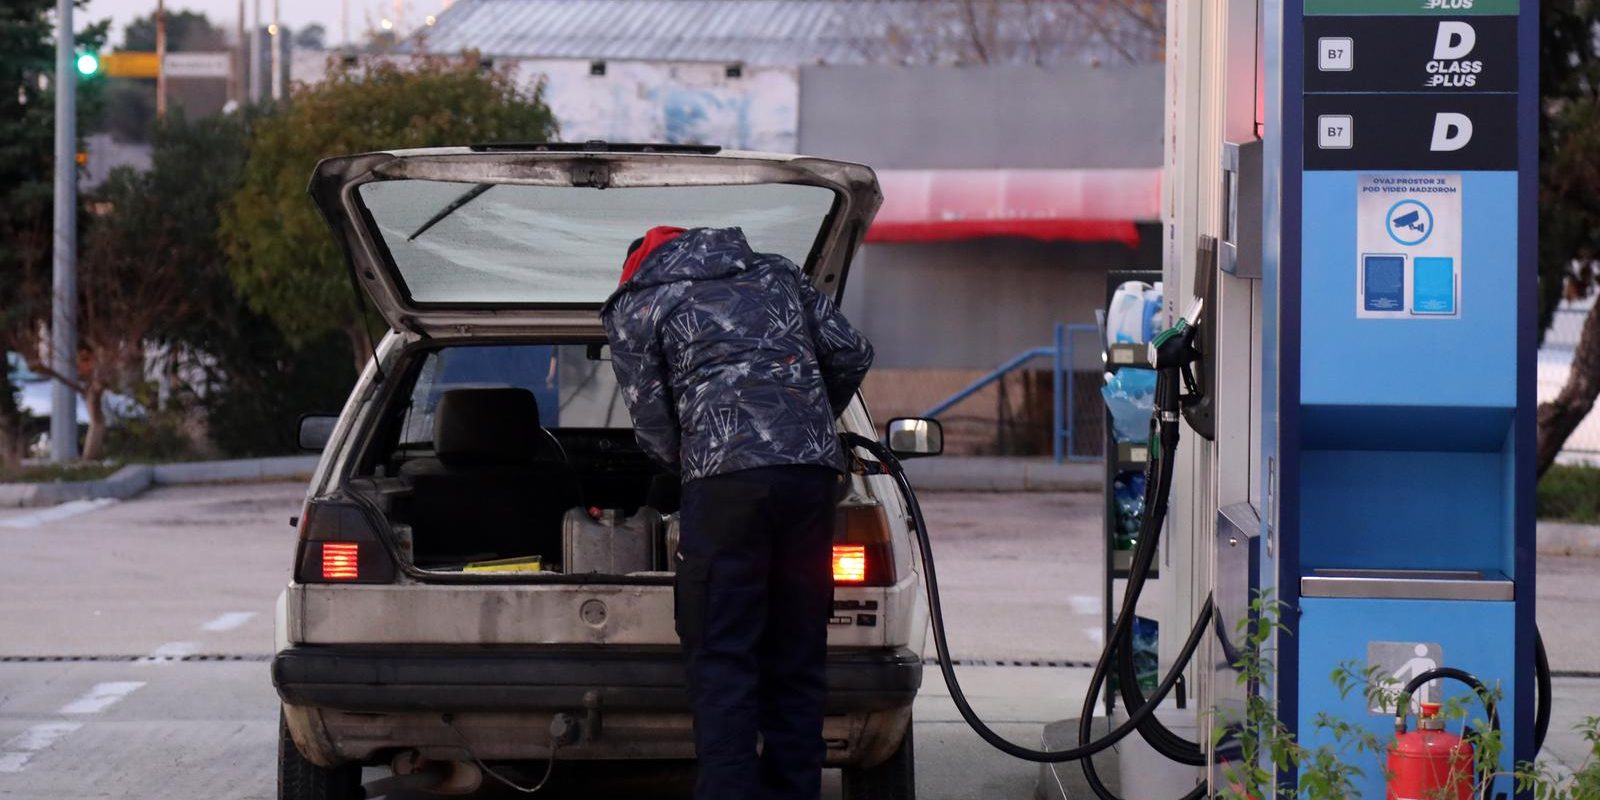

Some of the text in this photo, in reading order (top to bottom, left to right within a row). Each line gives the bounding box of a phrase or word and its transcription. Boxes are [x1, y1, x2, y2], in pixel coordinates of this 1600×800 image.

[1426, 0, 1473, 9] PLUS
[1433, 21, 1476, 59] D
[1328, 49, 1344, 59] B7
[1426, 60, 1482, 73] CLASS
[1428, 74, 1476, 87] PLUS
[1327, 127, 1343, 137] B7
[1430, 112, 1473, 151] D
